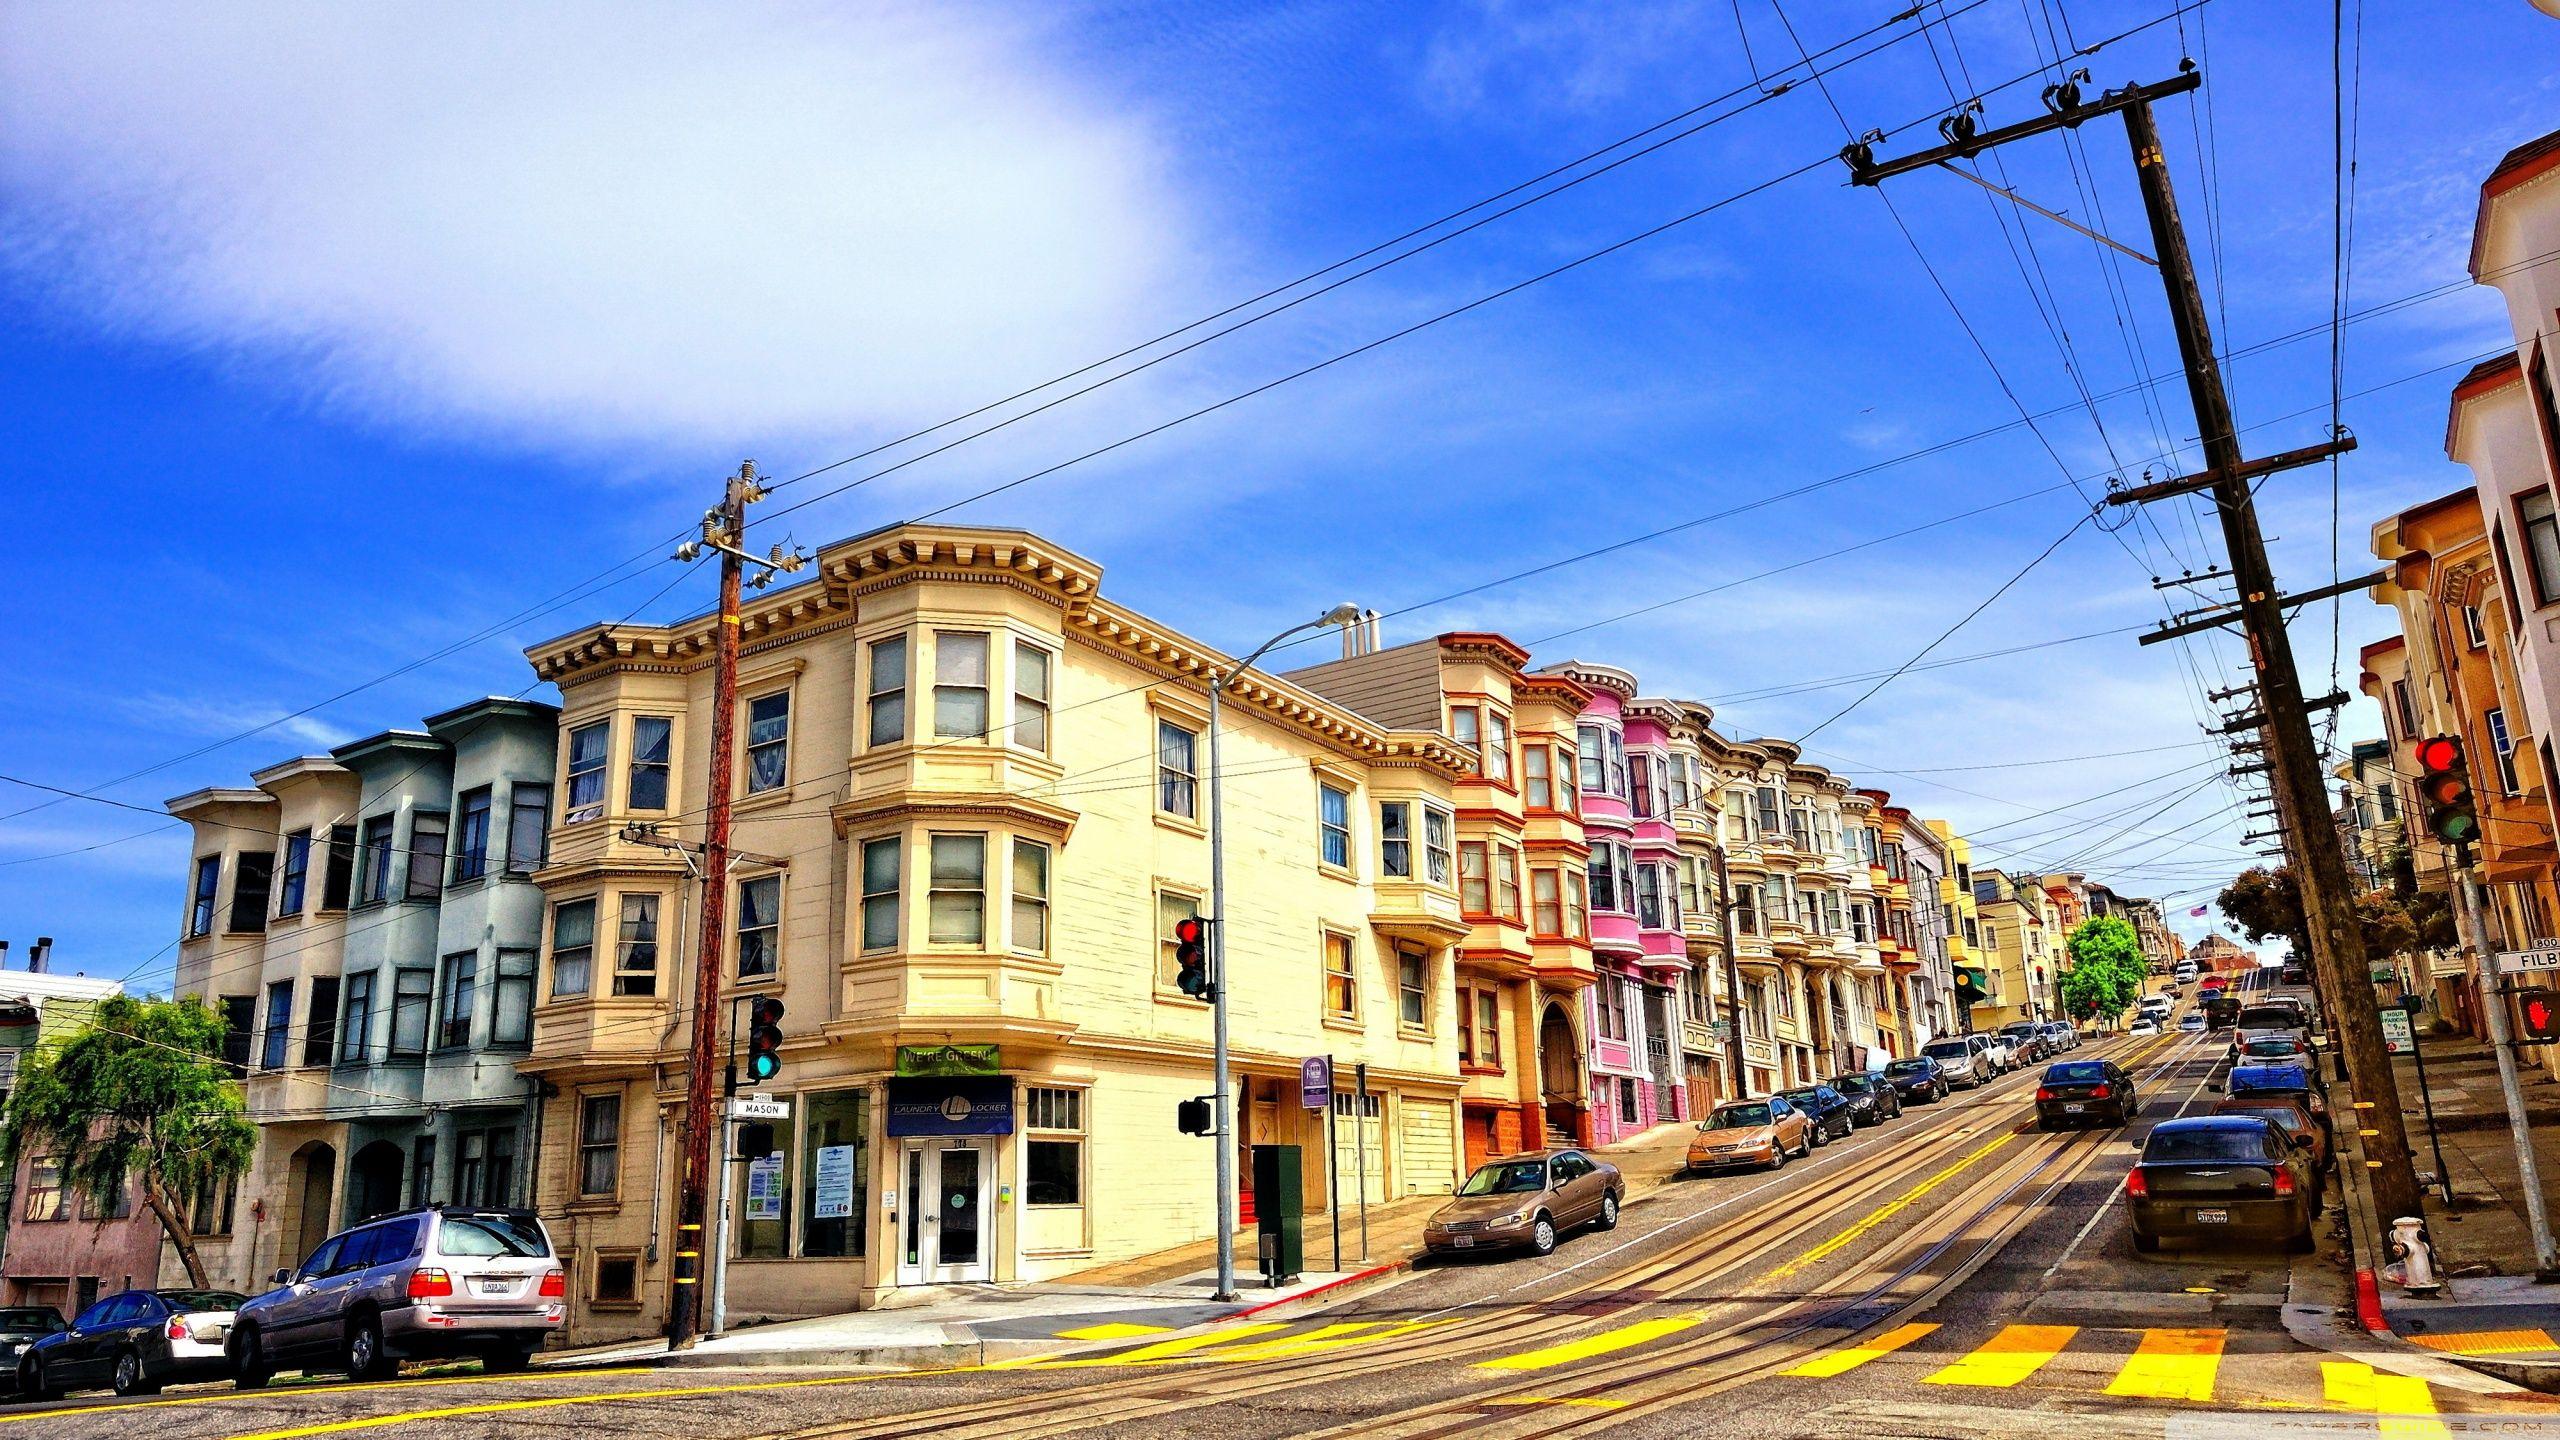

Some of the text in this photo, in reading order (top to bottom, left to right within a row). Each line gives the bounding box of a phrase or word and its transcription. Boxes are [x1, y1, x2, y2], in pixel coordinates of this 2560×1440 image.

[2537, 939, 2557, 948] 800
[2521, 952, 2560, 967] FILB
[904, 1049, 991, 1062] WE'RE GREEN!
[746, 1104, 779, 1114] MASON
[894, 1104, 1007, 1113] LAUNDRY LOCKER
